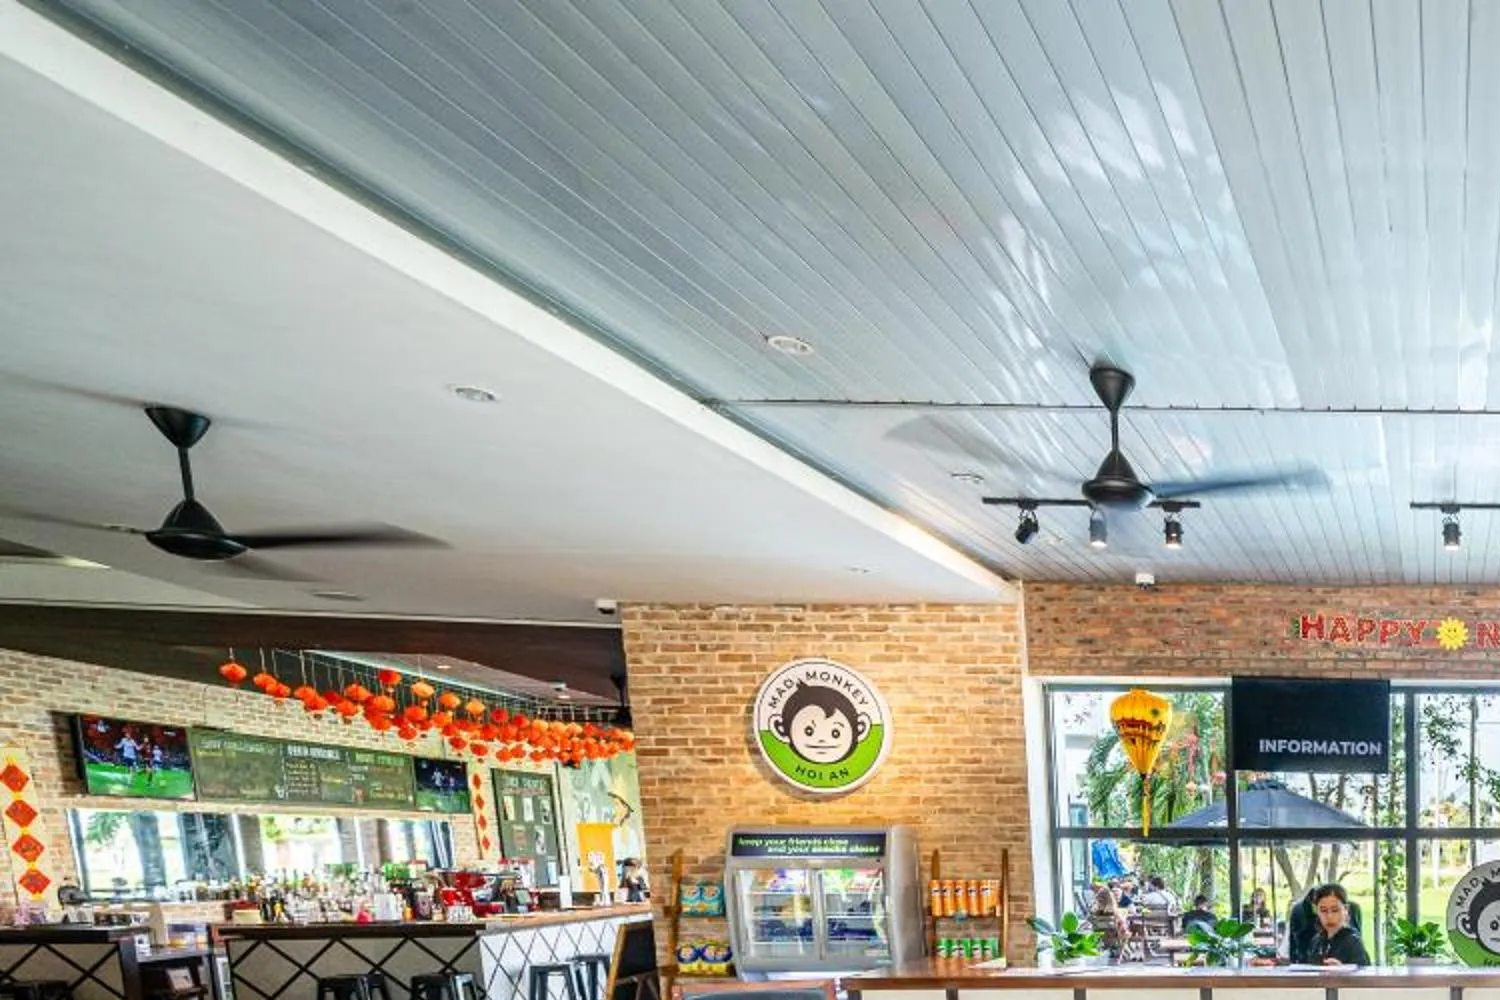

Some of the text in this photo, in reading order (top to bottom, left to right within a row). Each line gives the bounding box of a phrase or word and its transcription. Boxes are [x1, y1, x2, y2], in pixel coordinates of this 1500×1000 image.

[1301, 614, 1426, 648] HAPPY
[768, 671, 869, 709] MAD MONKEY
[1259, 738, 1382, 756] INFORMATION
[795, 765, 849, 781] HOI AN
[1457, 877, 1479, 907] MAD
